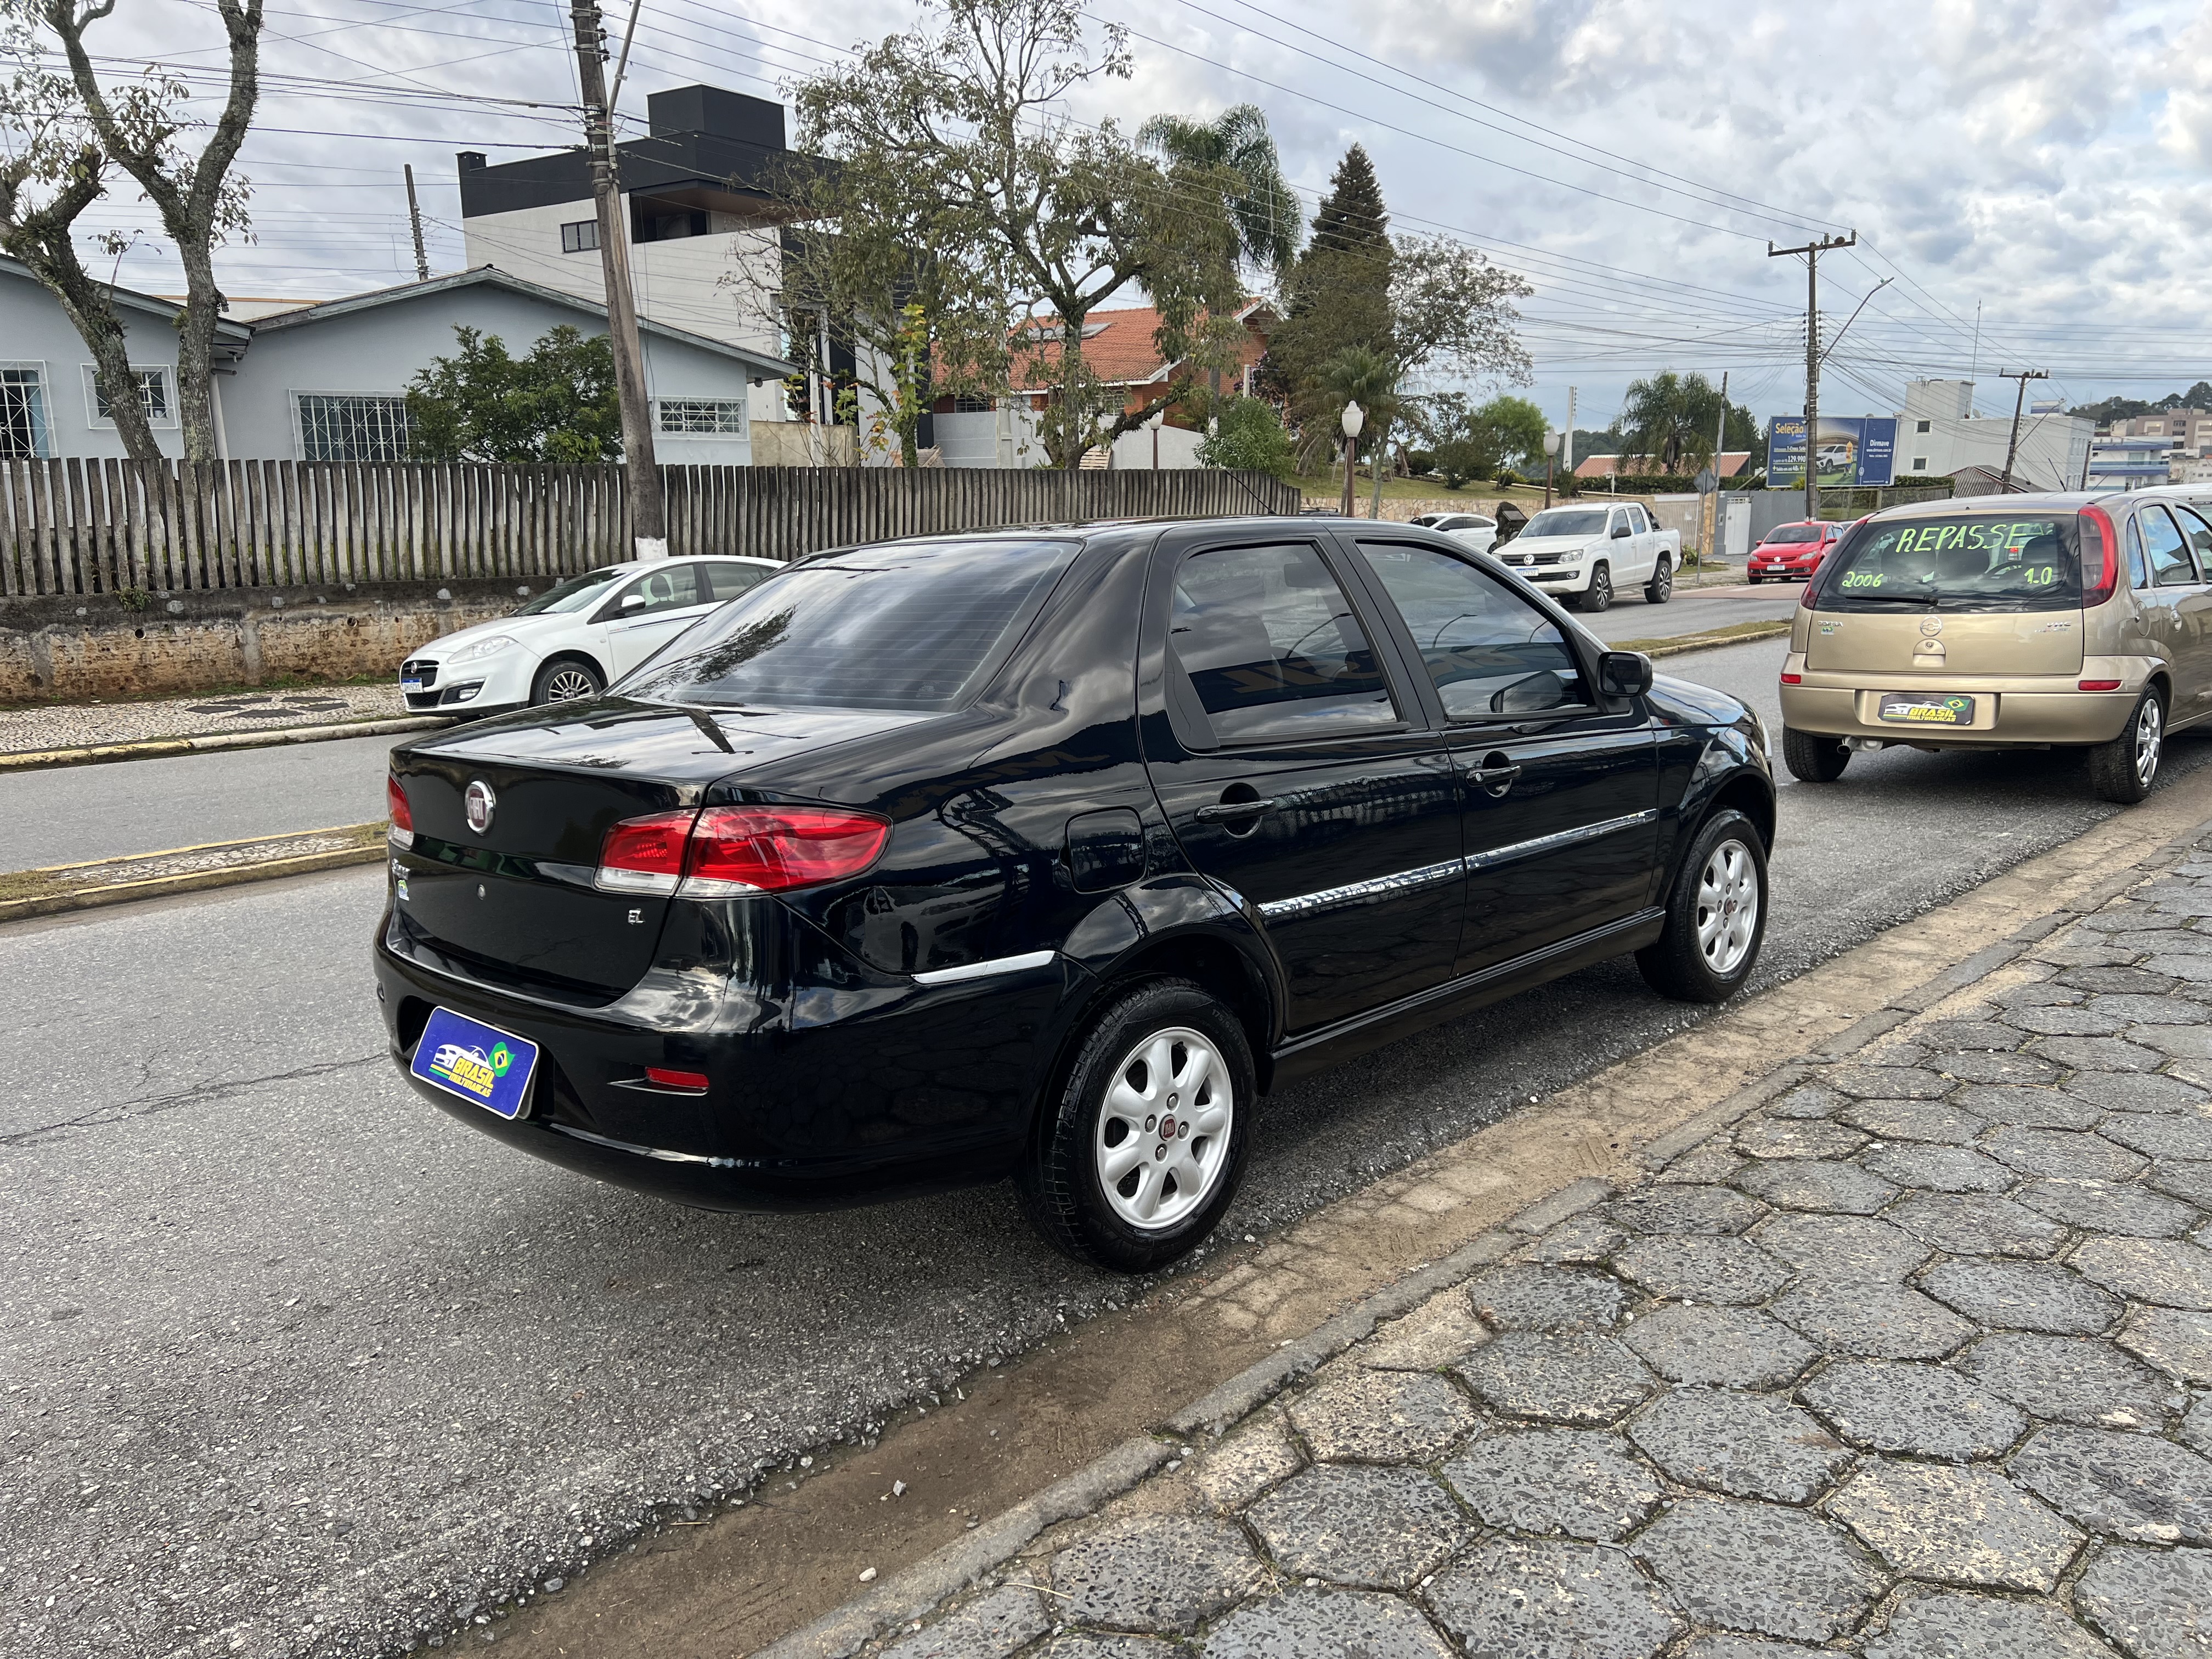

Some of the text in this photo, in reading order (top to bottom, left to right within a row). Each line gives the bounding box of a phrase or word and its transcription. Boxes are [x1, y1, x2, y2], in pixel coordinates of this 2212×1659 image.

[1775, 422, 1804, 437] Seleção
[1896, 523, 2031, 553] REPASSE
[1842, 571, 1884, 588] 2006
[1909, 708, 1956, 718] BRASIL
[628, 908, 644, 924] EL
[452, 1058, 495, 1088] BRASIL
[448, 1072, 493, 1098] MULTIMARCAS
